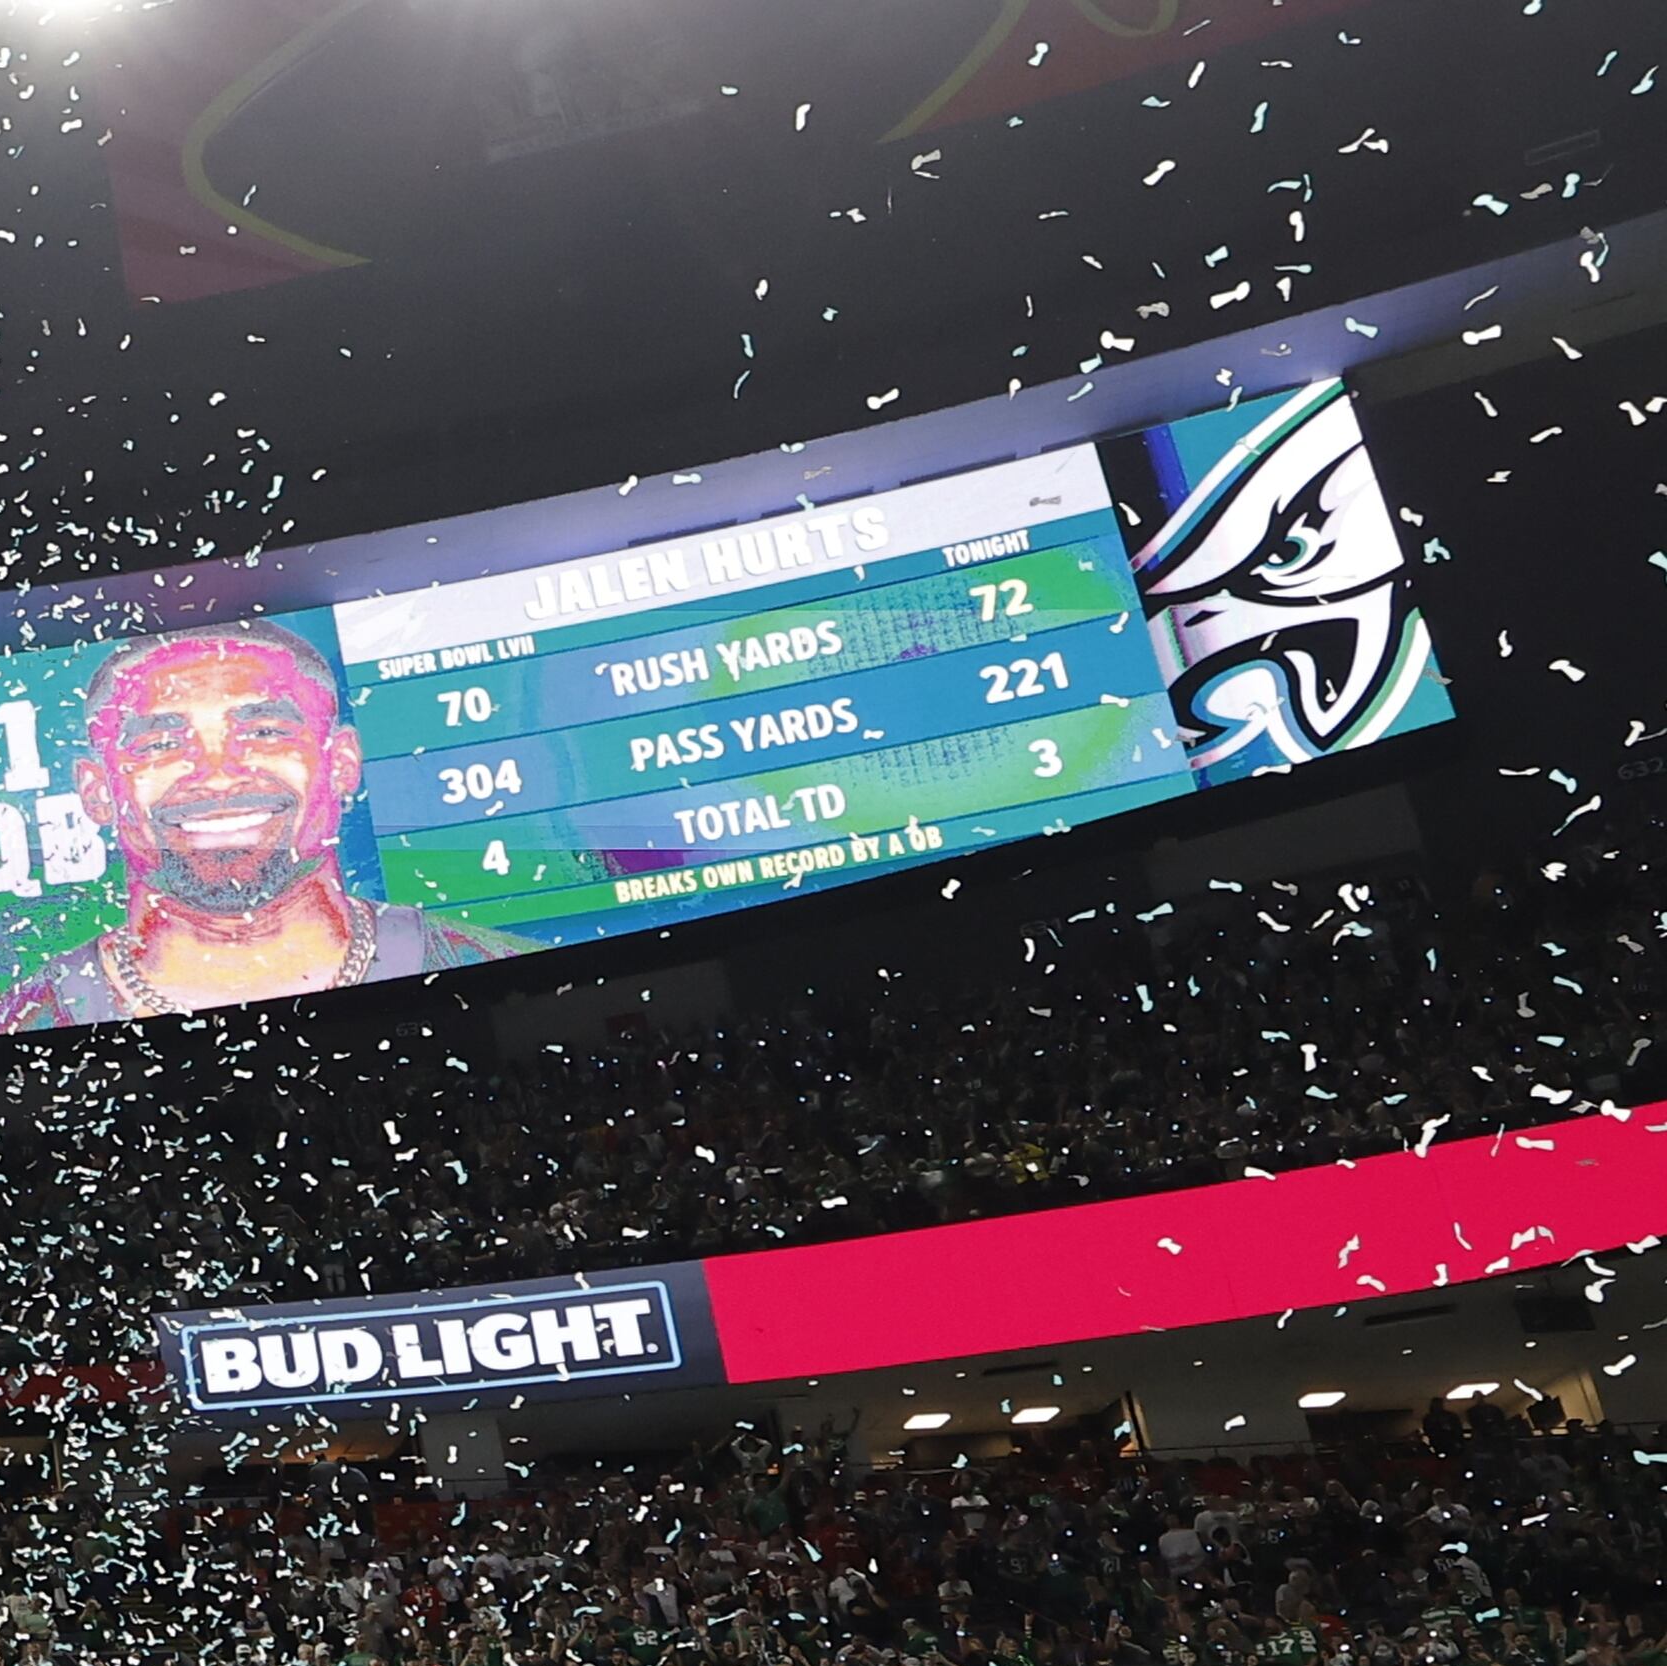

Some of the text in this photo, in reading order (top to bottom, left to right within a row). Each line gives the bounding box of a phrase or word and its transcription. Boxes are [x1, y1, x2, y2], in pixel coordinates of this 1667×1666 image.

[523, 504, 891, 622] JALEN HURTS
[941, 528, 1032, 568] TONIGHT
[378, 634, 536, 681] SUPER BOWL LVII
[437, 577, 1035, 728] 70 RUSH YARDS 72
[438, 652, 1071, 805] 304 PASS YARDS 221
[481, 738, 1064, 877] 4 TOTAL TD 3
[615, 869, 698, 905] BREAKS
[702, 860, 756, 891] OWN
[757, 845, 847, 883] RECORD
[851, 836, 885, 863] BY
[887, 833, 905, 856] A
[201, 1330, 383, 1395] BUD
[1269, 1637, 1295, 1656] 17
